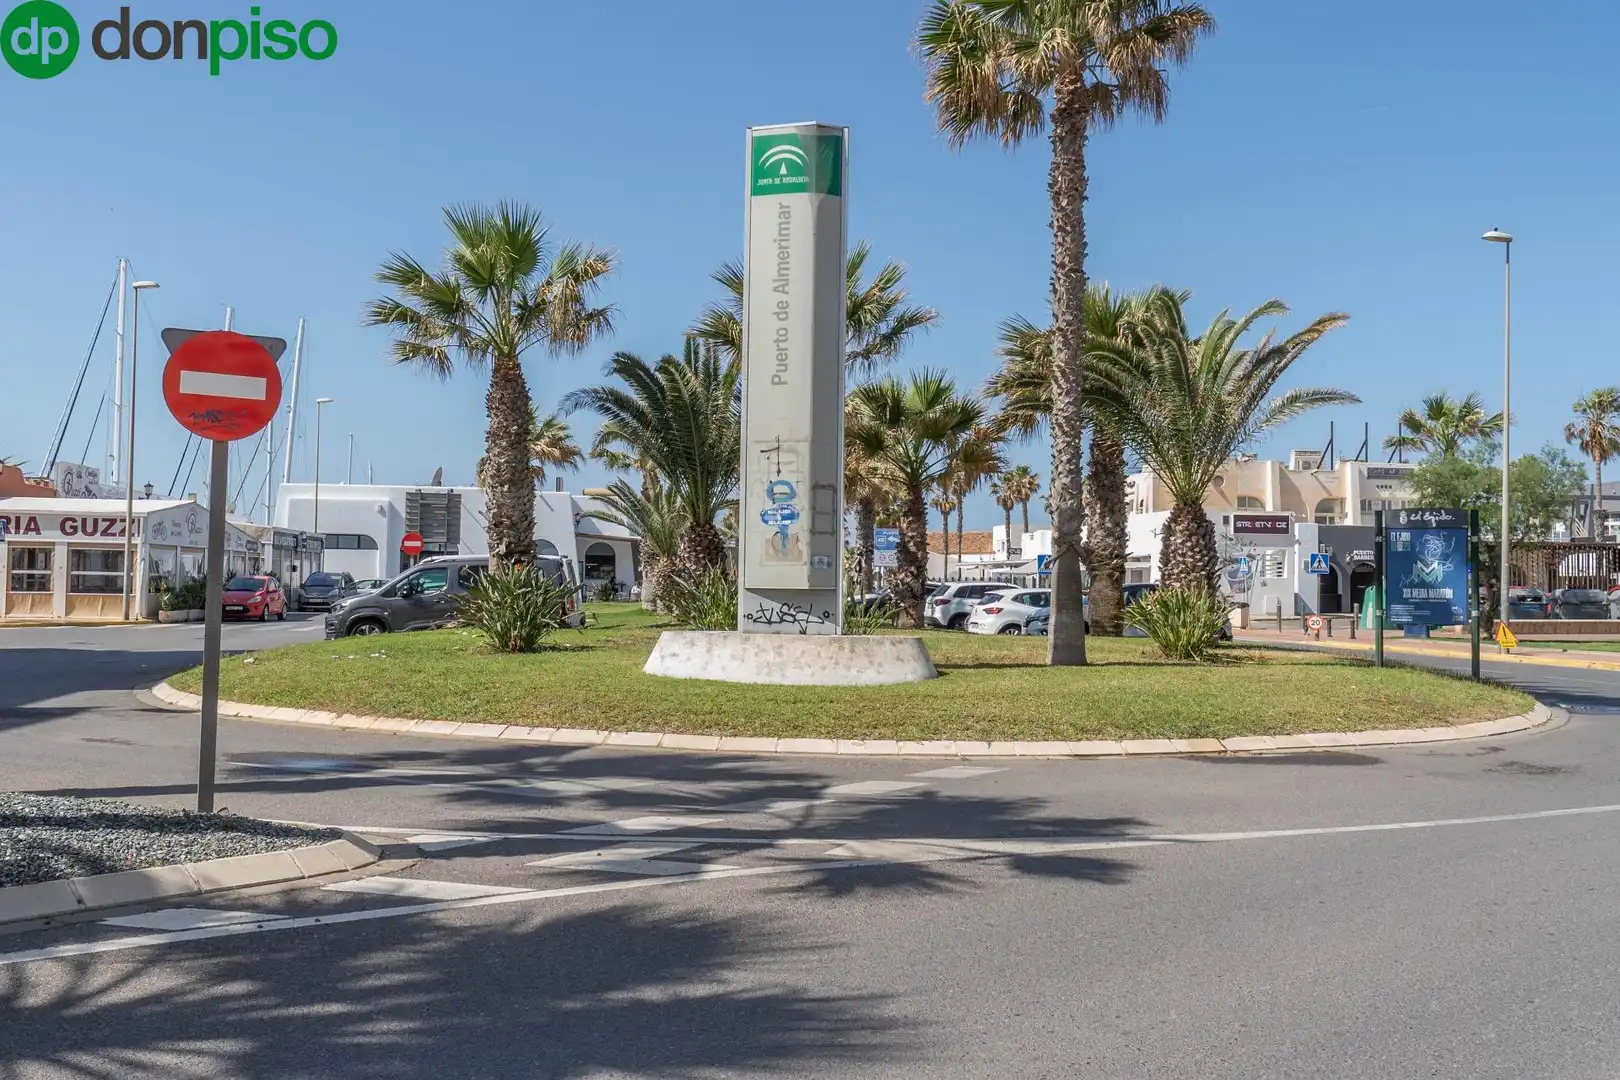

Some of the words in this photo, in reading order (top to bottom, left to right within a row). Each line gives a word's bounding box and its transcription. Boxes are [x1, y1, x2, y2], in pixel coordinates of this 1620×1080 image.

[772, 202, 791, 295] Almerimar
[772, 300, 789, 321] de
[771, 327, 788, 386] Puerto
[1412, 588, 1427, 598] MEDIA
